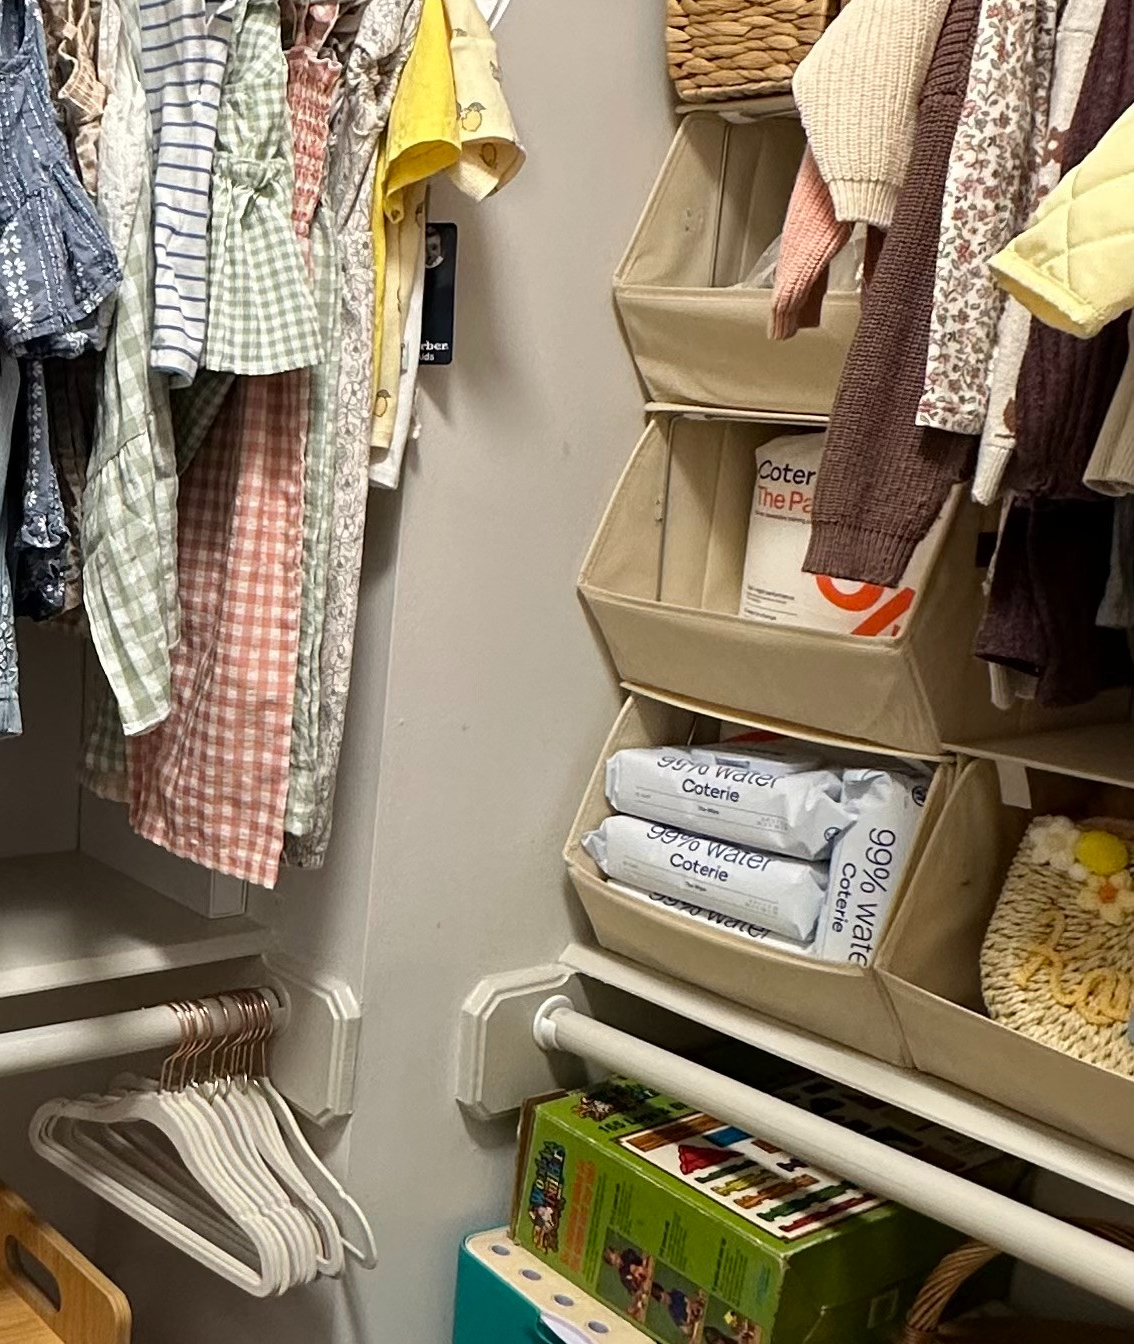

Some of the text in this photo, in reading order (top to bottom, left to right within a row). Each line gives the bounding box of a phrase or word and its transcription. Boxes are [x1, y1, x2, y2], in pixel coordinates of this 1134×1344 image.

[420, 340, 450, 351] rber
[757, 459, 816, 485] Coter
[757, 485, 812, 515] The Pa
[681, 776, 740, 803] Coterie
[646, 822, 774, 871] 99% water
[669, 852, 729, 882] Coterie
[832, 862, 857, 933] Coterie
[848, 827, 897, 967] 99% wate
